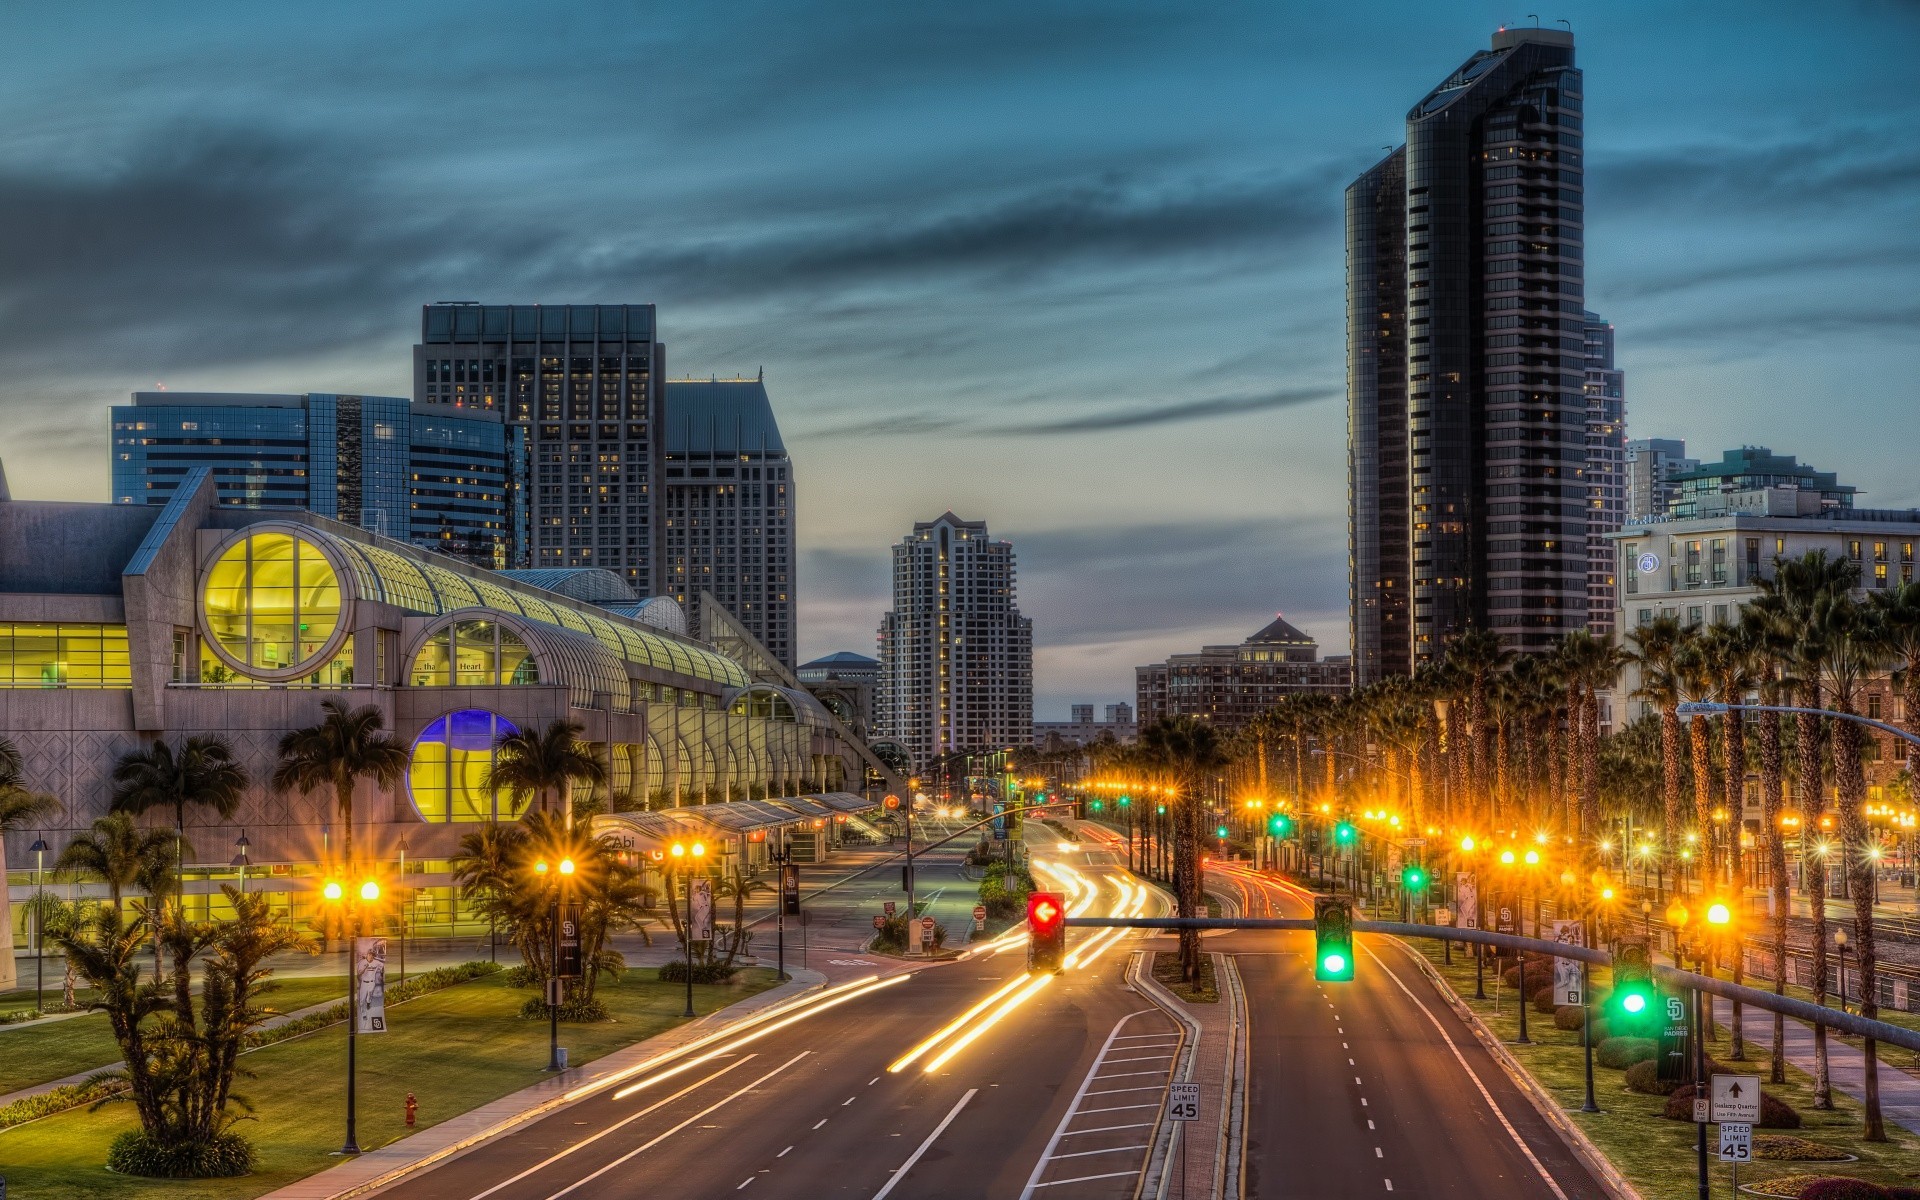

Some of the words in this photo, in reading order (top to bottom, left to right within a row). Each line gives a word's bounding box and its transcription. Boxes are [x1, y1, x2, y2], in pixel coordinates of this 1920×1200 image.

[1171, 1085, 1199, 1093] SPEED
[1171, 1103, 1197, 1118] 45
[1721, 1125, 1750, 1133] SPEED
[1722, 1143, 1749, 1159] 45
